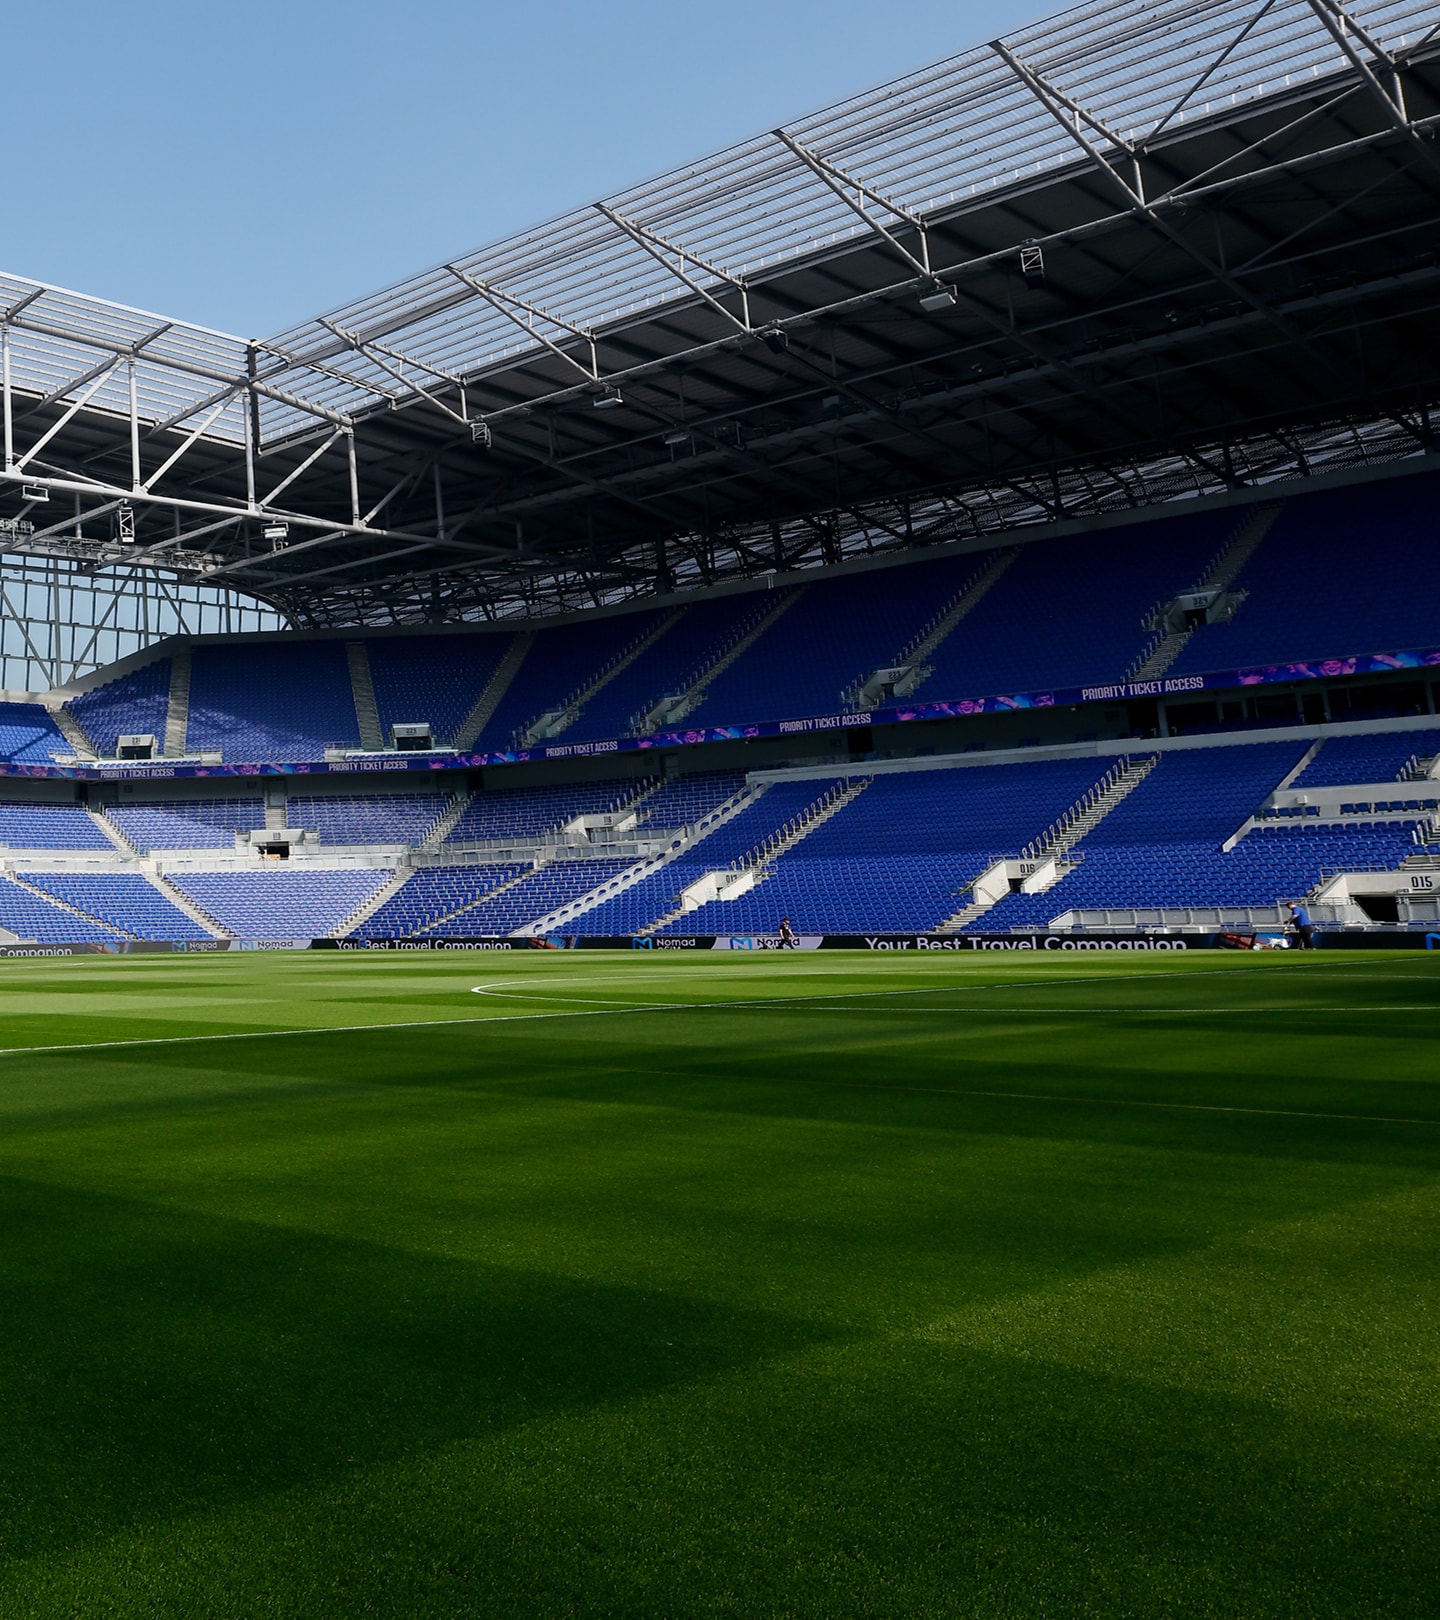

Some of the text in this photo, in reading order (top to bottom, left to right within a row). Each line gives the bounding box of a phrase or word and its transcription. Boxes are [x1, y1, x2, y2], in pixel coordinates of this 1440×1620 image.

[1081, 676, 1204, 700] PRIORITY TICKET ACCESS
[779, 713, 872, 733] PRIORITY TICKET ACCESS
[545, 741, 618, 757] PRIORITY TICKET ACCESS
[328, 760, 408, 771] PRIORITY TICKET ACCESS
[100, 767, 175, 779] PRIORITY TICKET ACCESS
[1020, 863, 1035, 874] 016
[1411, 876, 1433, 888] 015
[189, 942, 218, 950] Nomad
[258, 940, 294, 949] Nomad
[335, 939, 512, 950] You Best Travel Companion
[656, 938, 696, 947] Nomad
[864, 936, 1187, 950] Your Best Travel Companion
